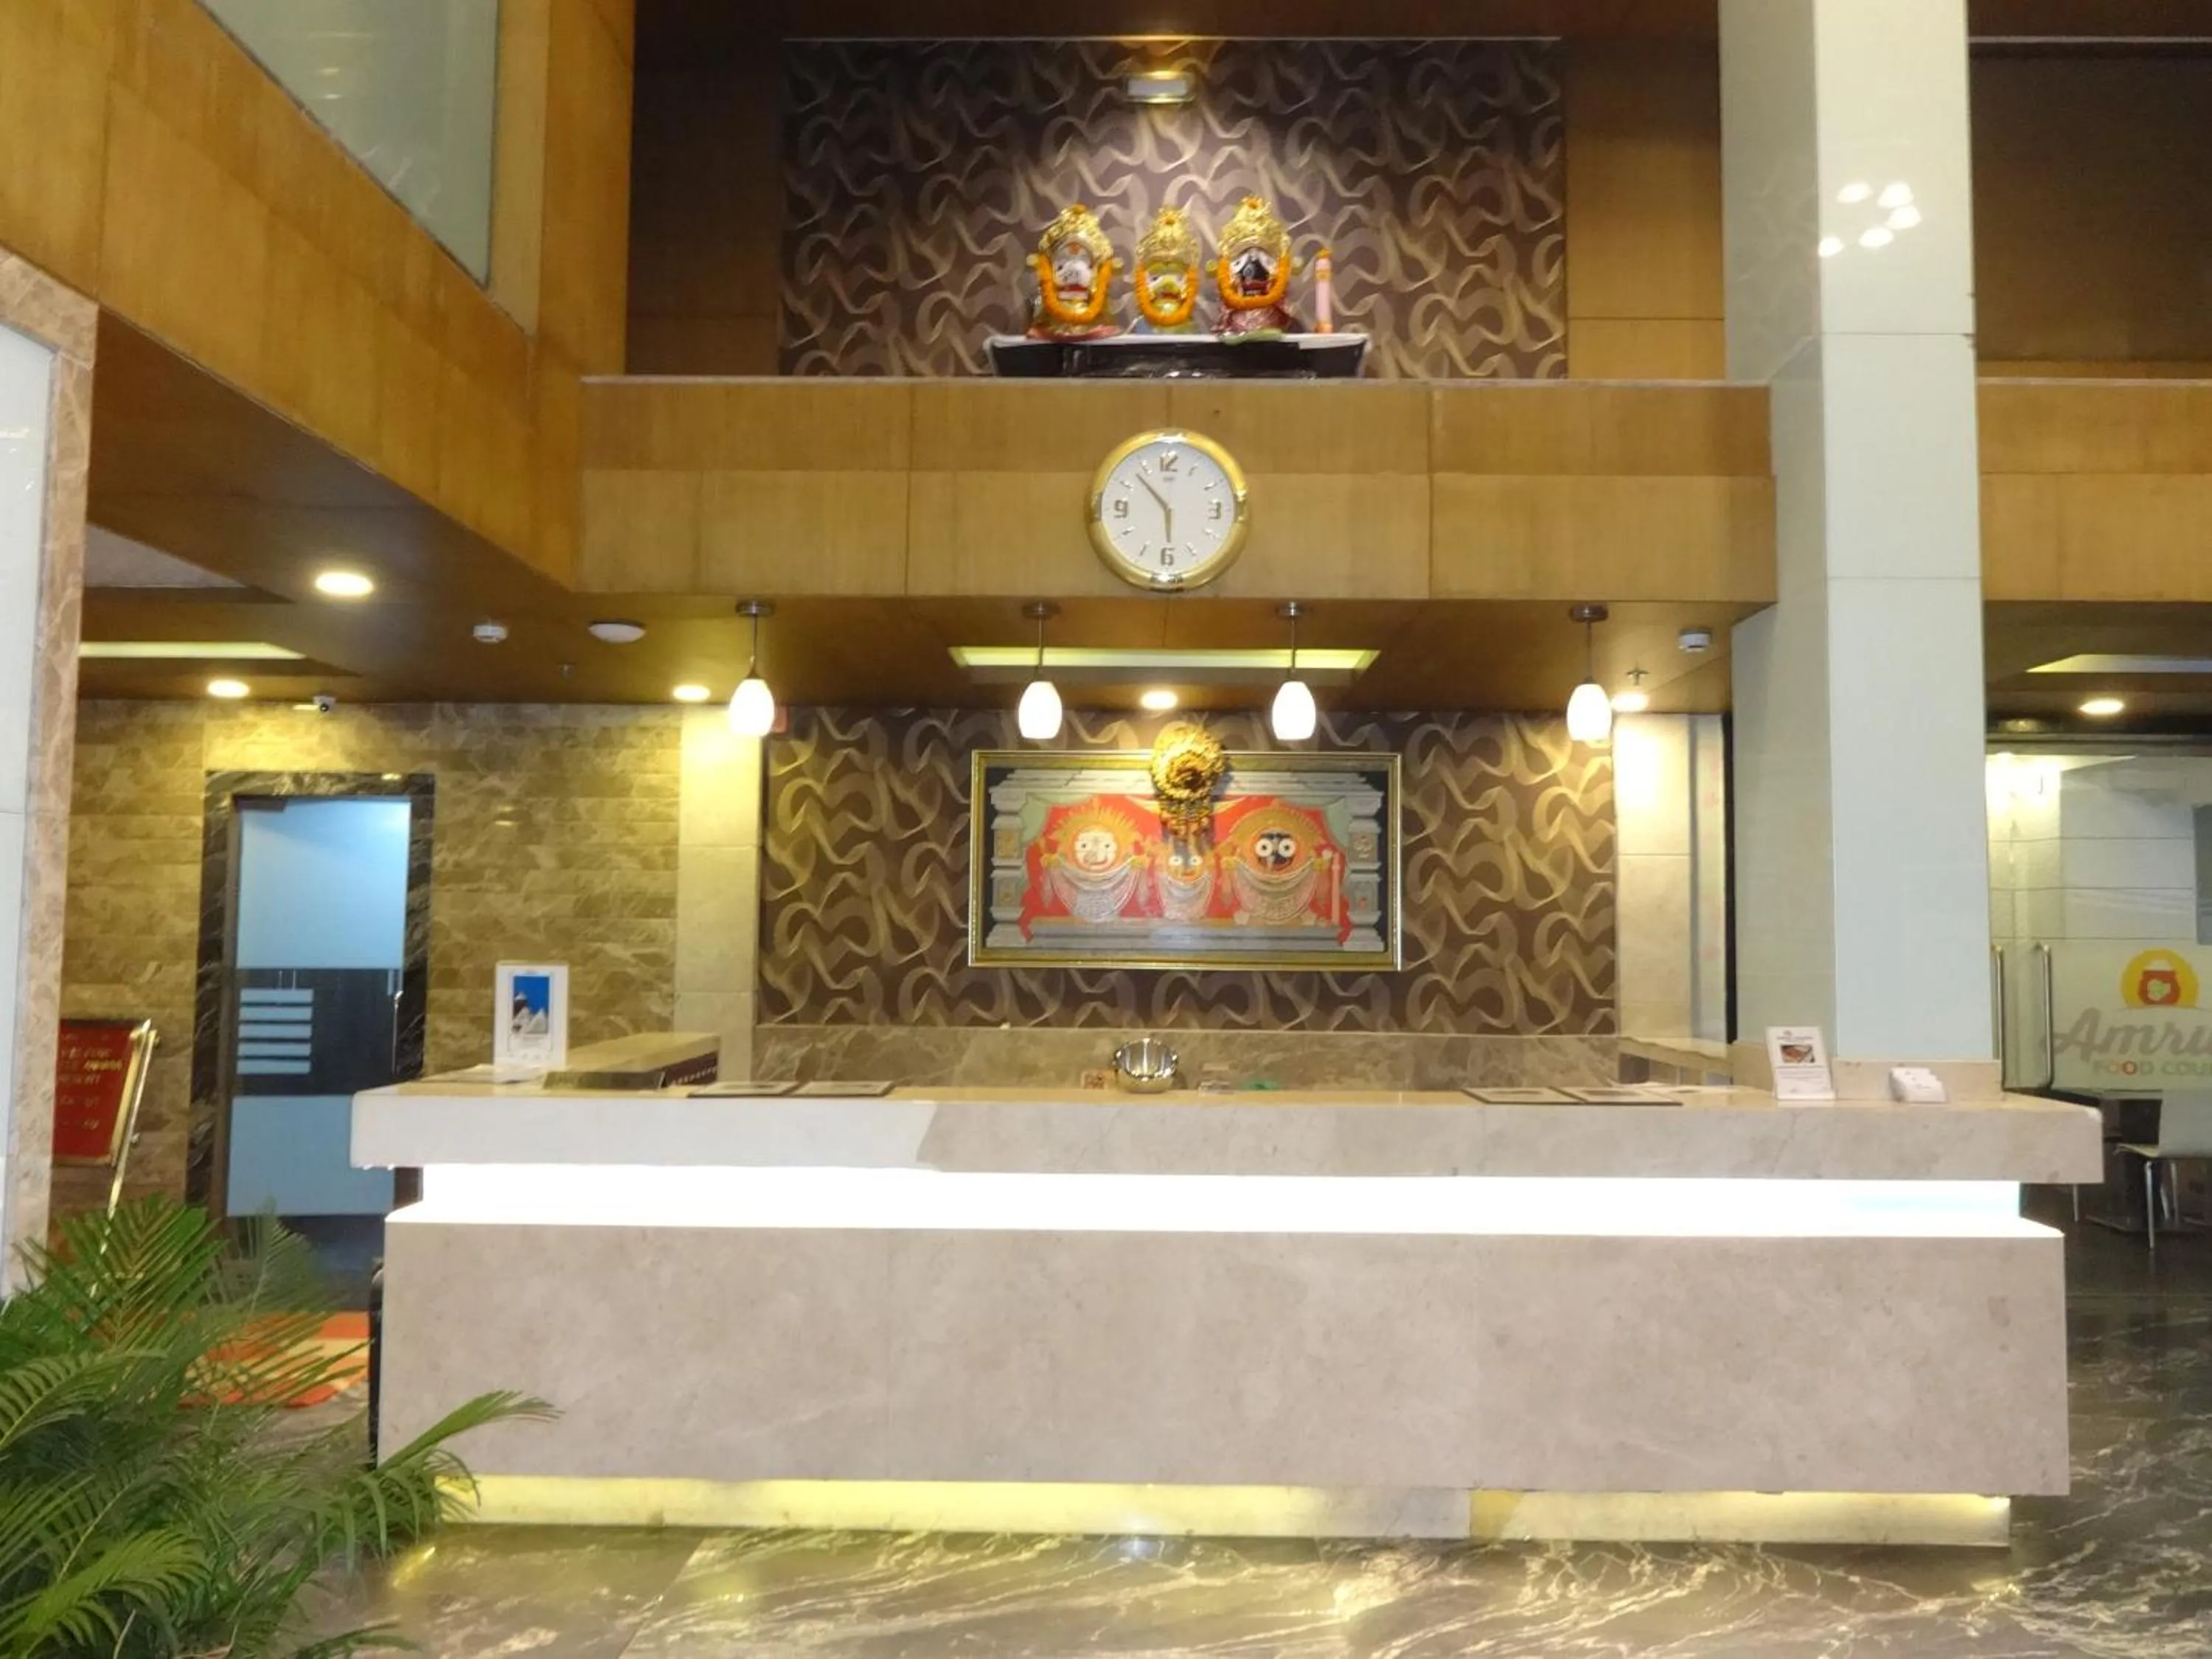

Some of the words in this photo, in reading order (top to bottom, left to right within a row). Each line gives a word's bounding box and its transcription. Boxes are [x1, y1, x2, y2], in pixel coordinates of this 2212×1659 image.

[1160, 452, 1178, 473] 12
[1113, 499, 1128, 518] 9
[1208, 499, 1222, 520] 3
[1160, 547, 1175, 566] 6
[2093, 1060, 2154, 1076] FOOD
[2161, 1060, 2212, 1077] COU
